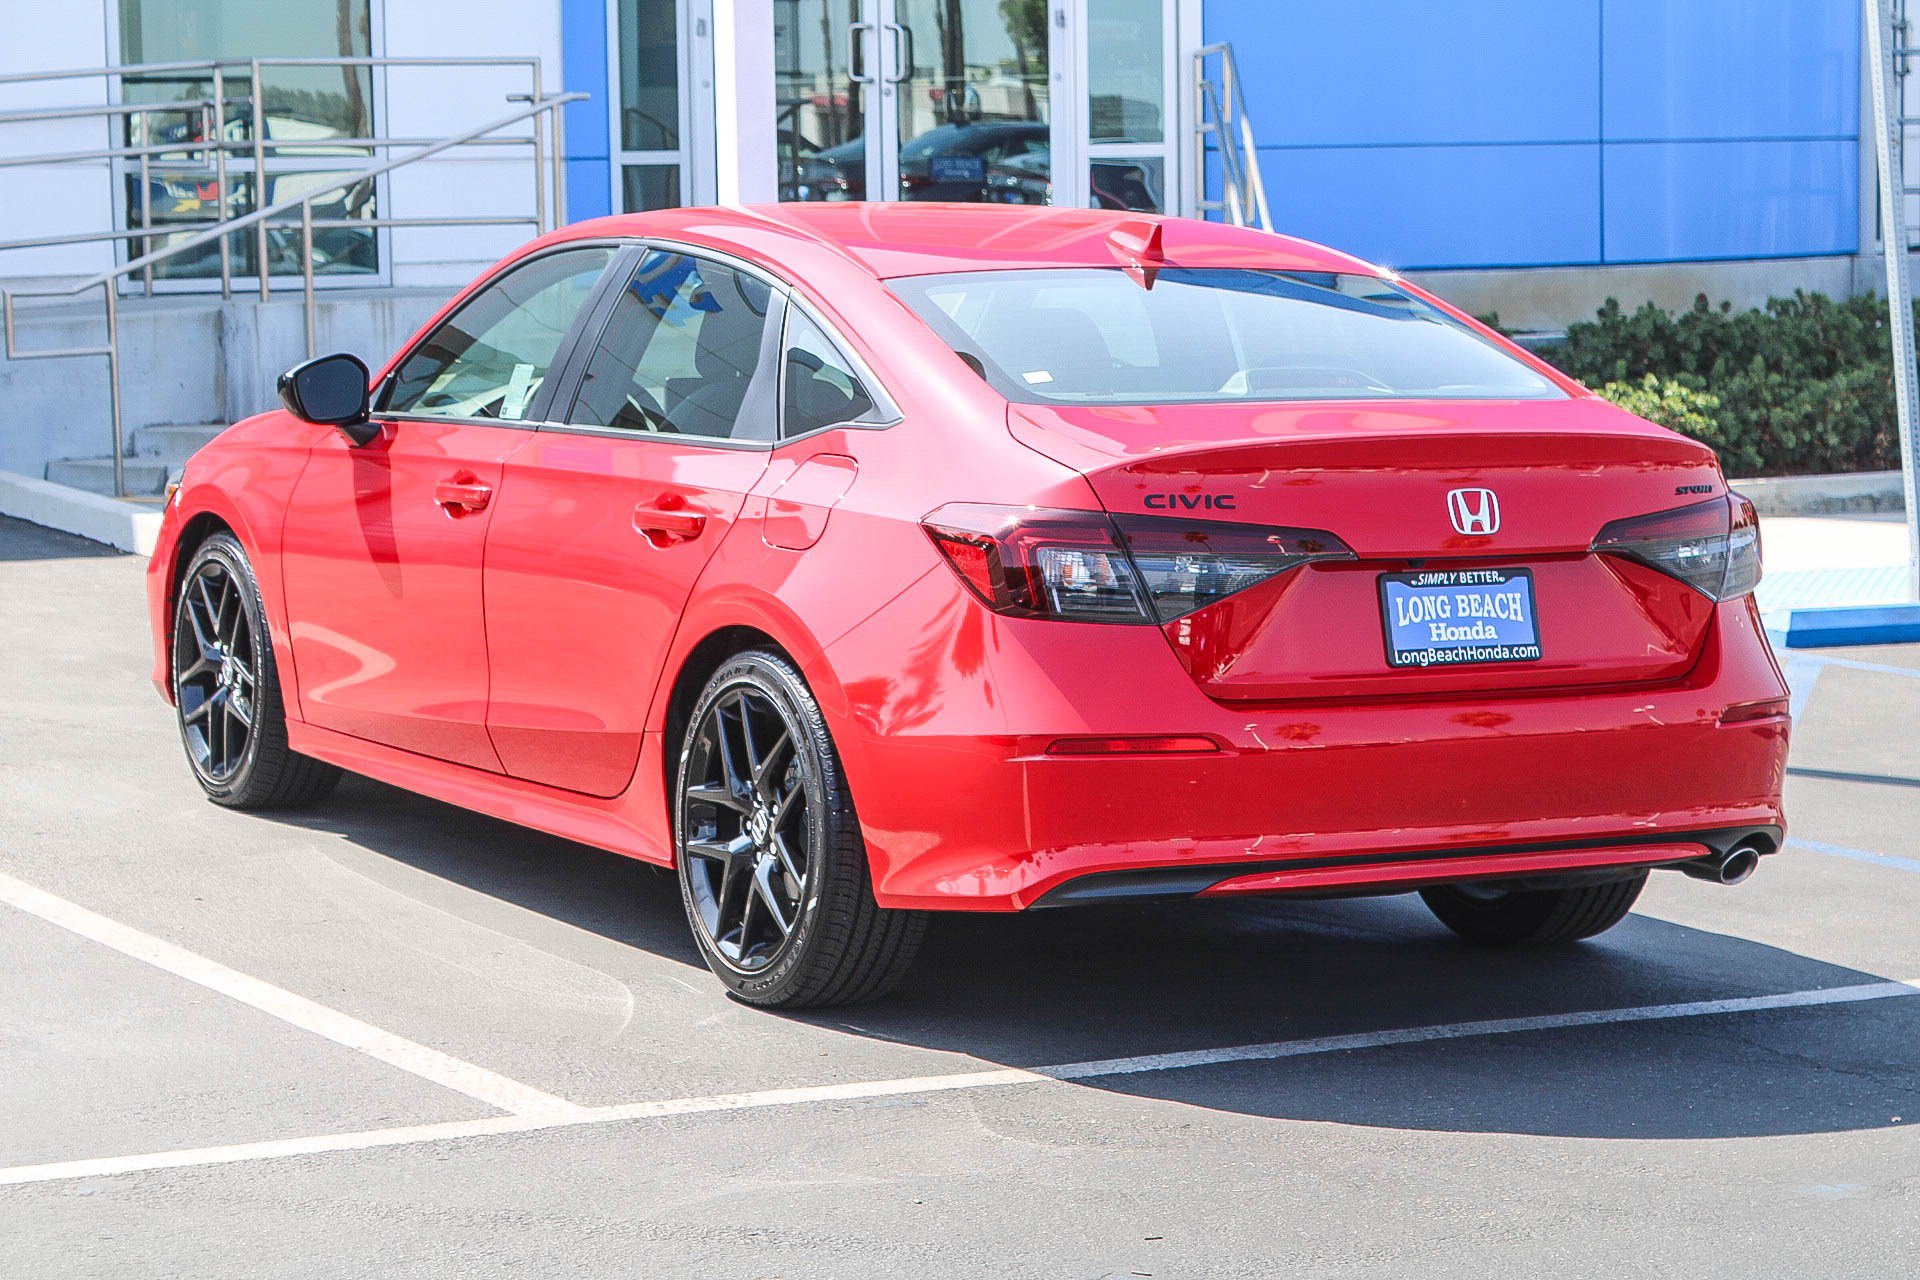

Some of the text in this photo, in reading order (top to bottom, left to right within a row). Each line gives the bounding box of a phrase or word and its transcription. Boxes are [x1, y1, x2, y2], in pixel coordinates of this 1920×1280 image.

[1143, 493, 1237, 510] CIVIC
[1417, 571, 1499, 586] SIMPLY BETTER
[1395, 592, 1524, 627] LONG BEACH
[1428, 620, 1498, 642] Honda
[1394, 644, 1540, 667] LongBeachHonda.com
